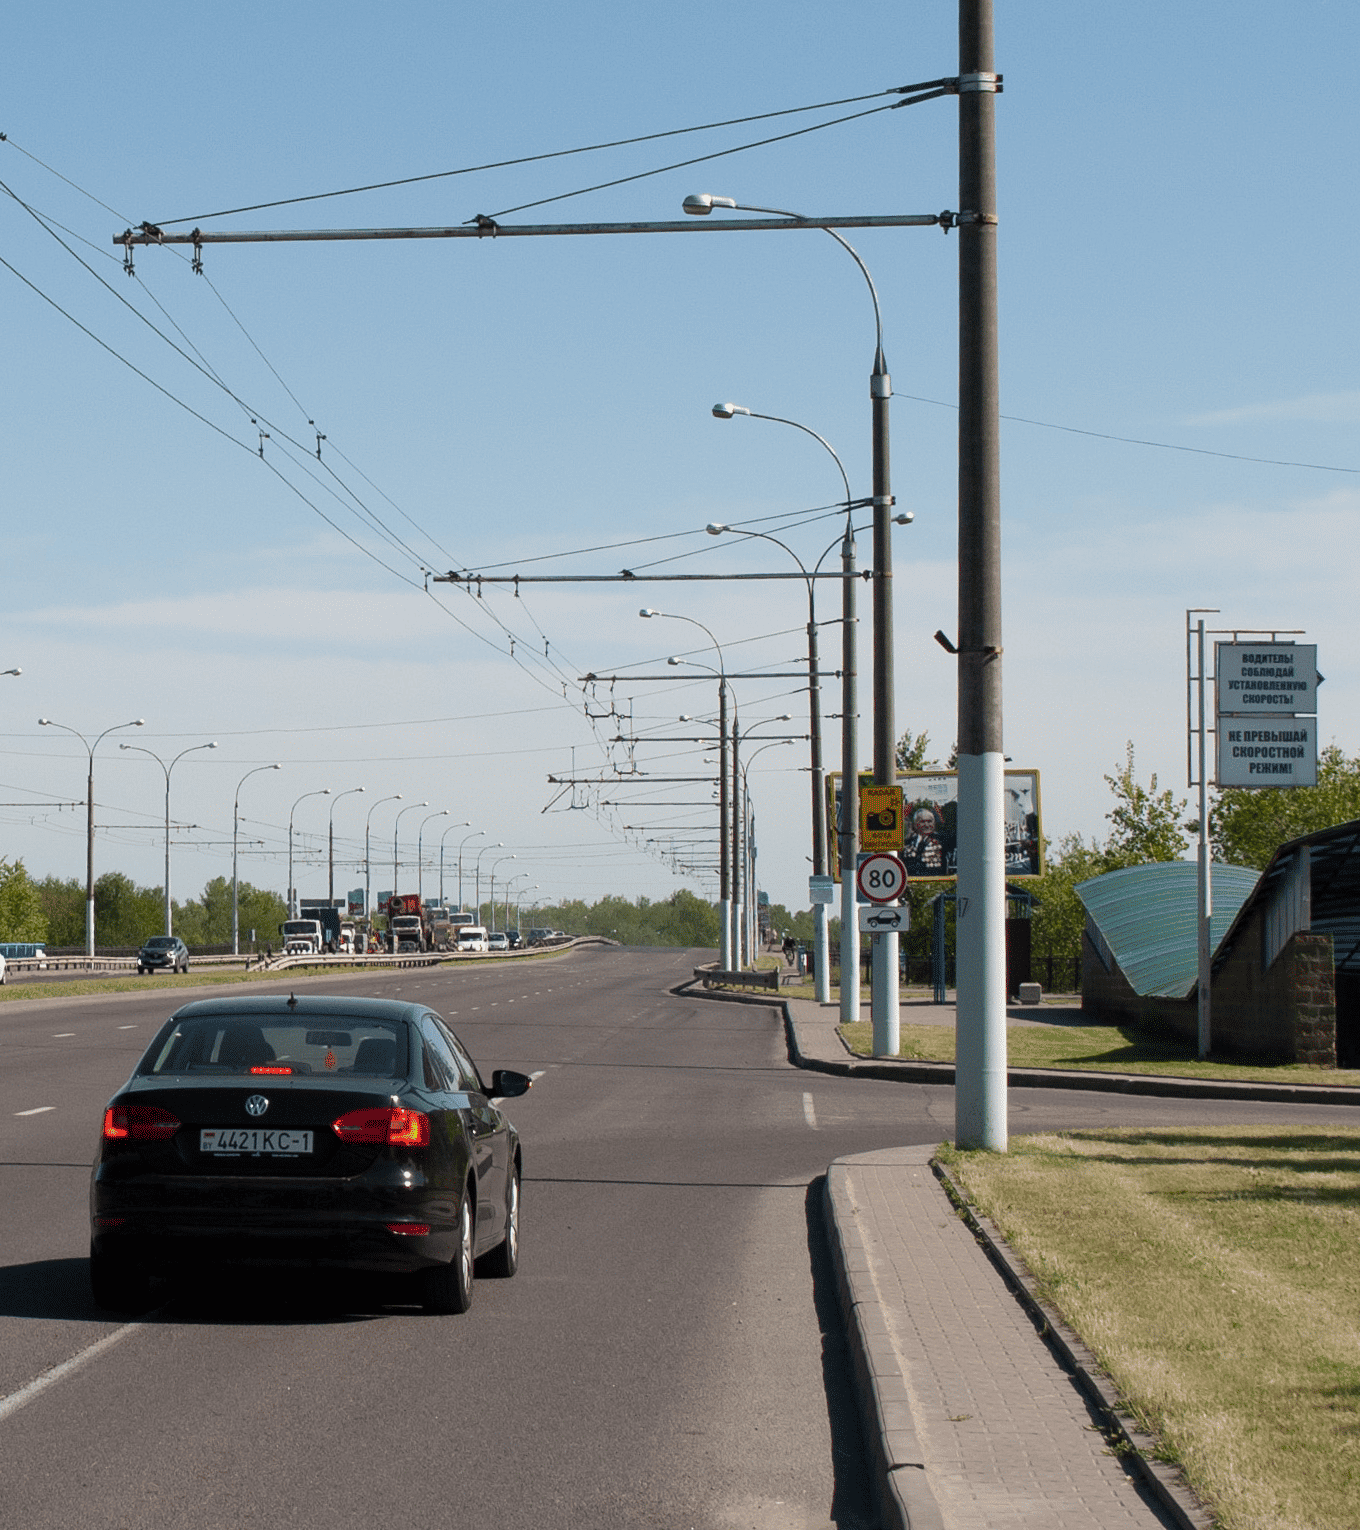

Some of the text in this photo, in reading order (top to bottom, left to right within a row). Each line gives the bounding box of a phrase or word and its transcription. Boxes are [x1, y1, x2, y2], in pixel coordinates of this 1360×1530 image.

[1242, 654, 1294, 665] ВОДИТЕЛЬ!
[1241, 666, 1294, 678] СОБЛЮДАЙ
[1228, 680, 1308, 691] УСТАНОВЛЕННУЮ
[1242, 694, 1294, 704] СКОРОСТЬ!
[1228, 729, 1308, 742] НЕ ПРЕВЫШАЙ
[1232, 745, 1305, 758] СКОРОСТНОЙ
[1249, 762, 1292, 774] РЕЖИМ!
[869, 869, 896, 888] 80
